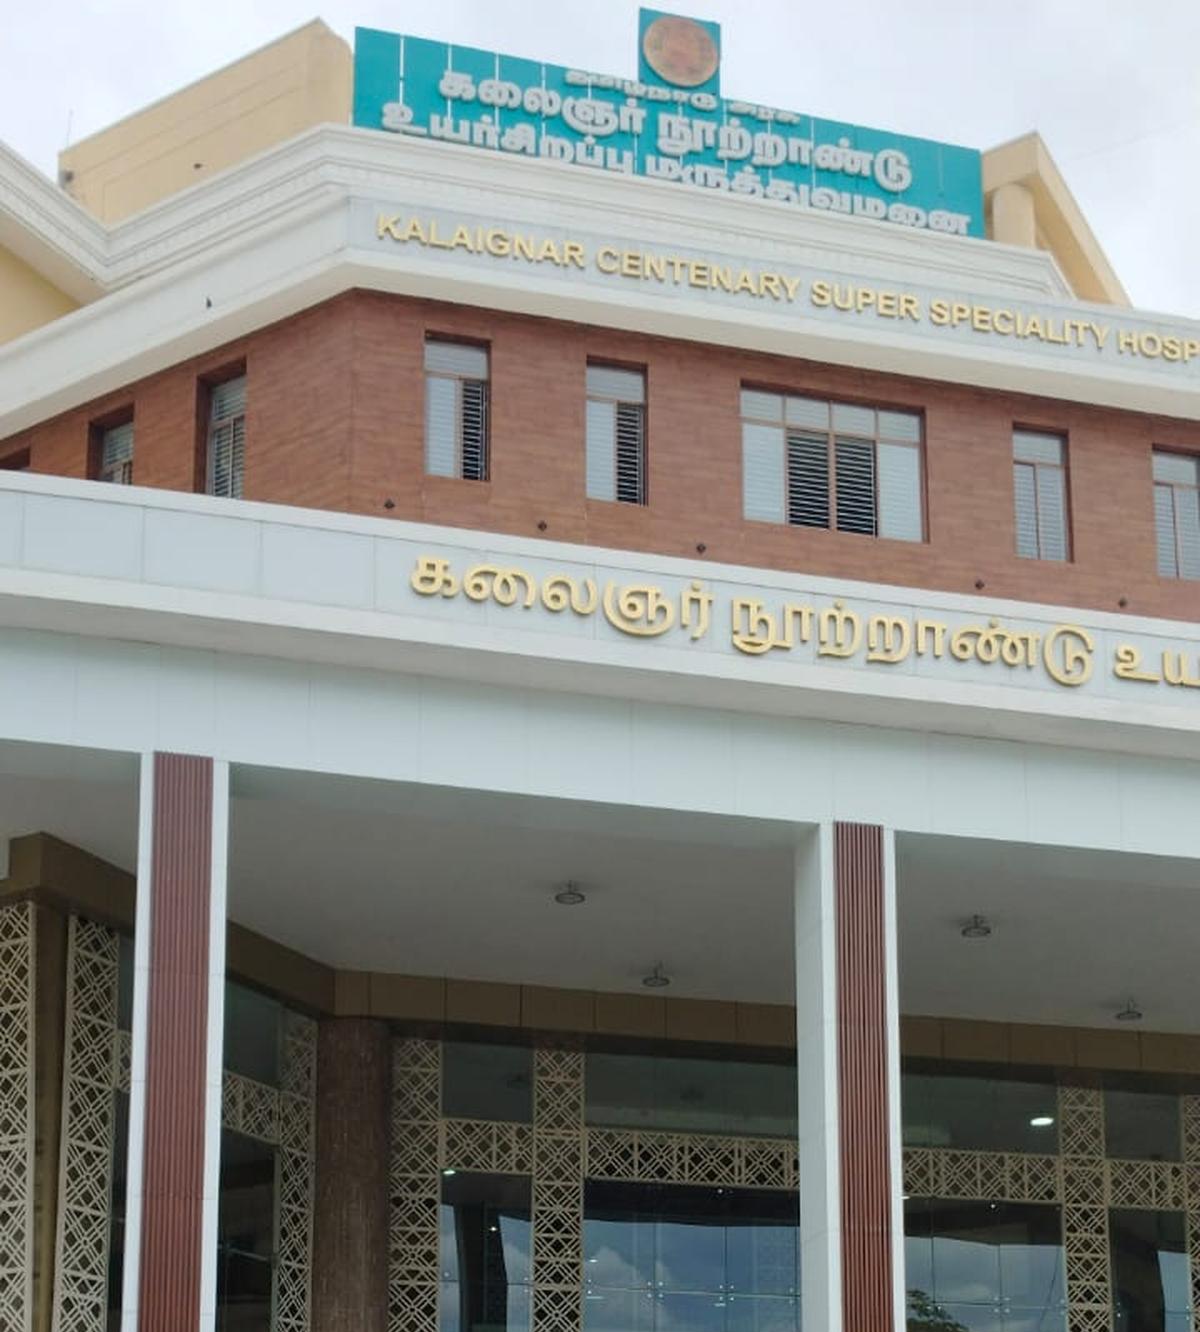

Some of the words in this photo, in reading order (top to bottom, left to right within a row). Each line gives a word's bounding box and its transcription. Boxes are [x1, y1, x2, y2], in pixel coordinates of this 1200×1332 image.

[438, 69, 647, 138] கலைஞர்
[656, 108, 913, 193] நூற்றாண்டு
[377, 212, 585, 270] KALAIGNAR
[596, 245, 798, 302] CENTENARY
[811, 280, 921, 321] SUPER
[930, 298, 1110, 350] SPECIALITY
[410, 554, 713, 640] கலைஞர்
[732, 599, 1094, 687] நூற்றாண்டு
